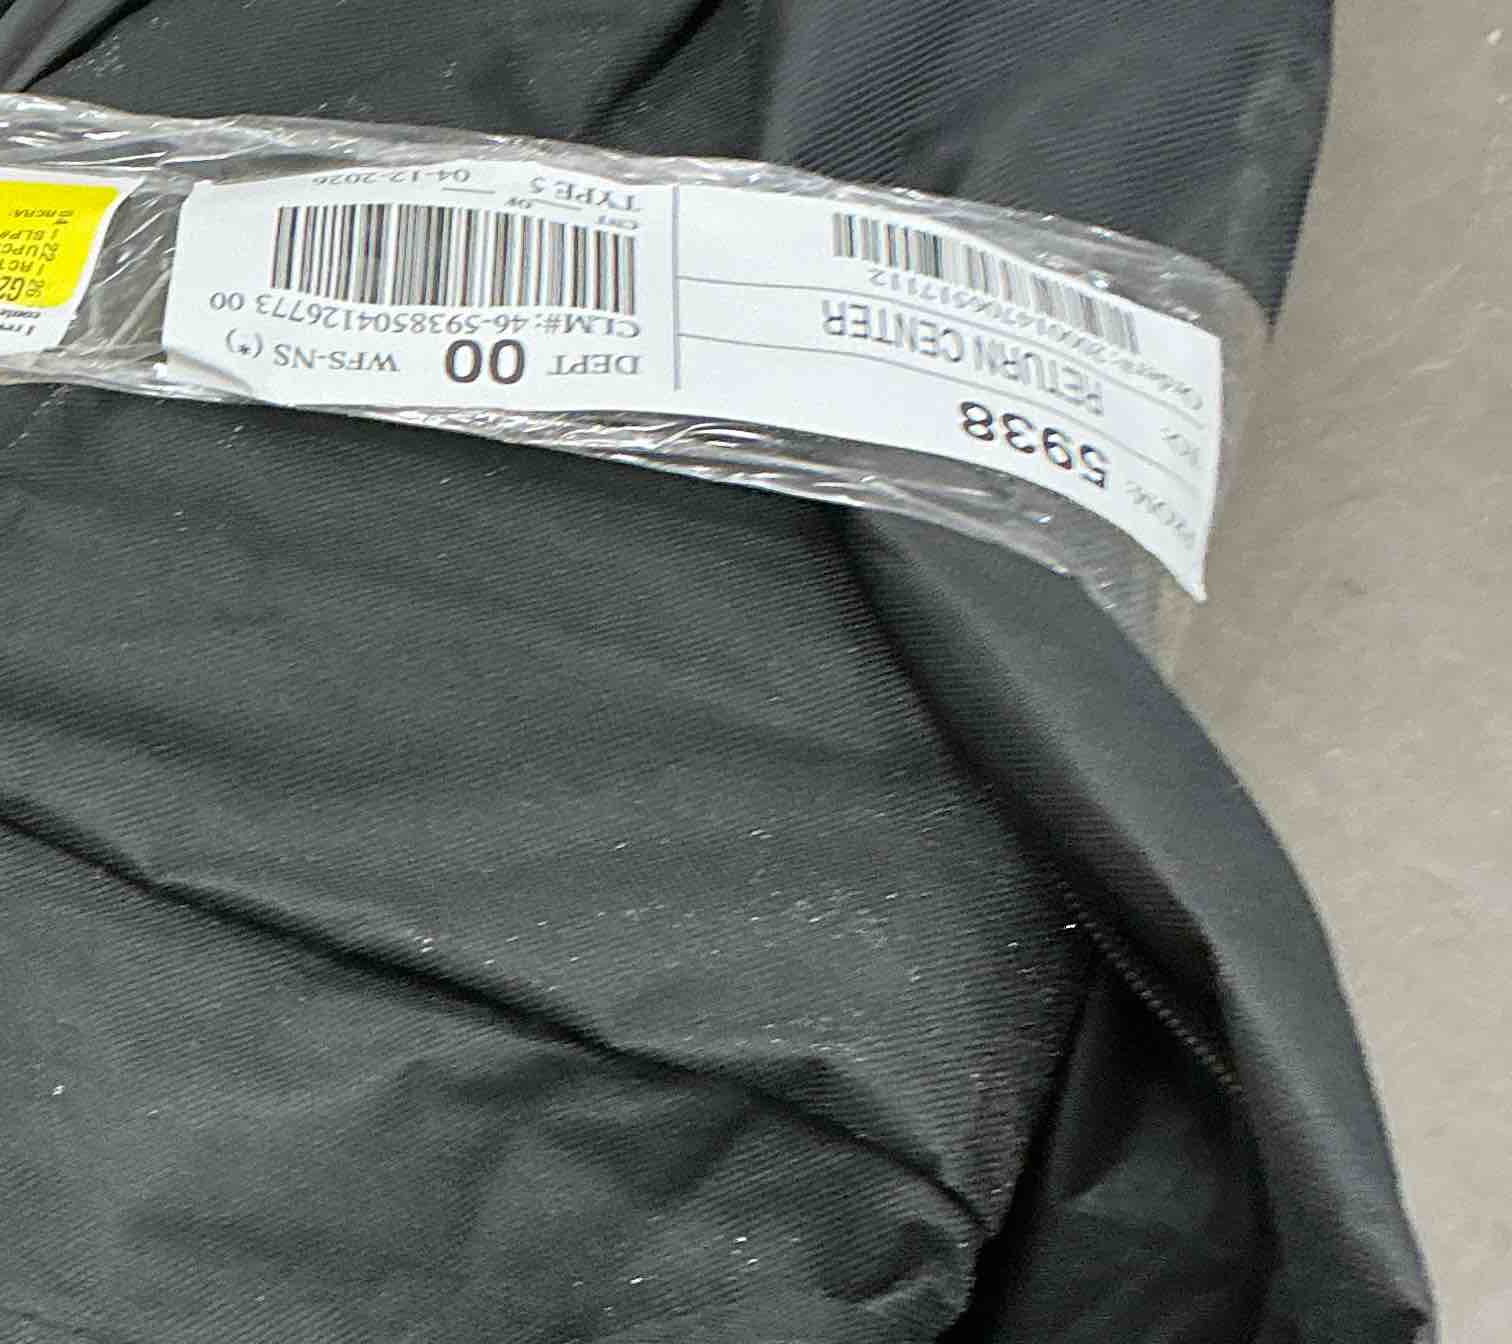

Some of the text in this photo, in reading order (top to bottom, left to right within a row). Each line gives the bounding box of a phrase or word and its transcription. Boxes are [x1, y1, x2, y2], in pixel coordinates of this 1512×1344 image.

[529, 176, 642, 213] TYPE 5
[208, 291, 640, 340] CLM#: 46-5938504126773 00
[273, 344, 397, 373] WFS-NS
[444, 338, 526, 385] 00
[547, 353, 640, 376] DEPT
[820, 300, 1103, 417] RETURN CENTER
[960, 402, 1107, 489] 5938
